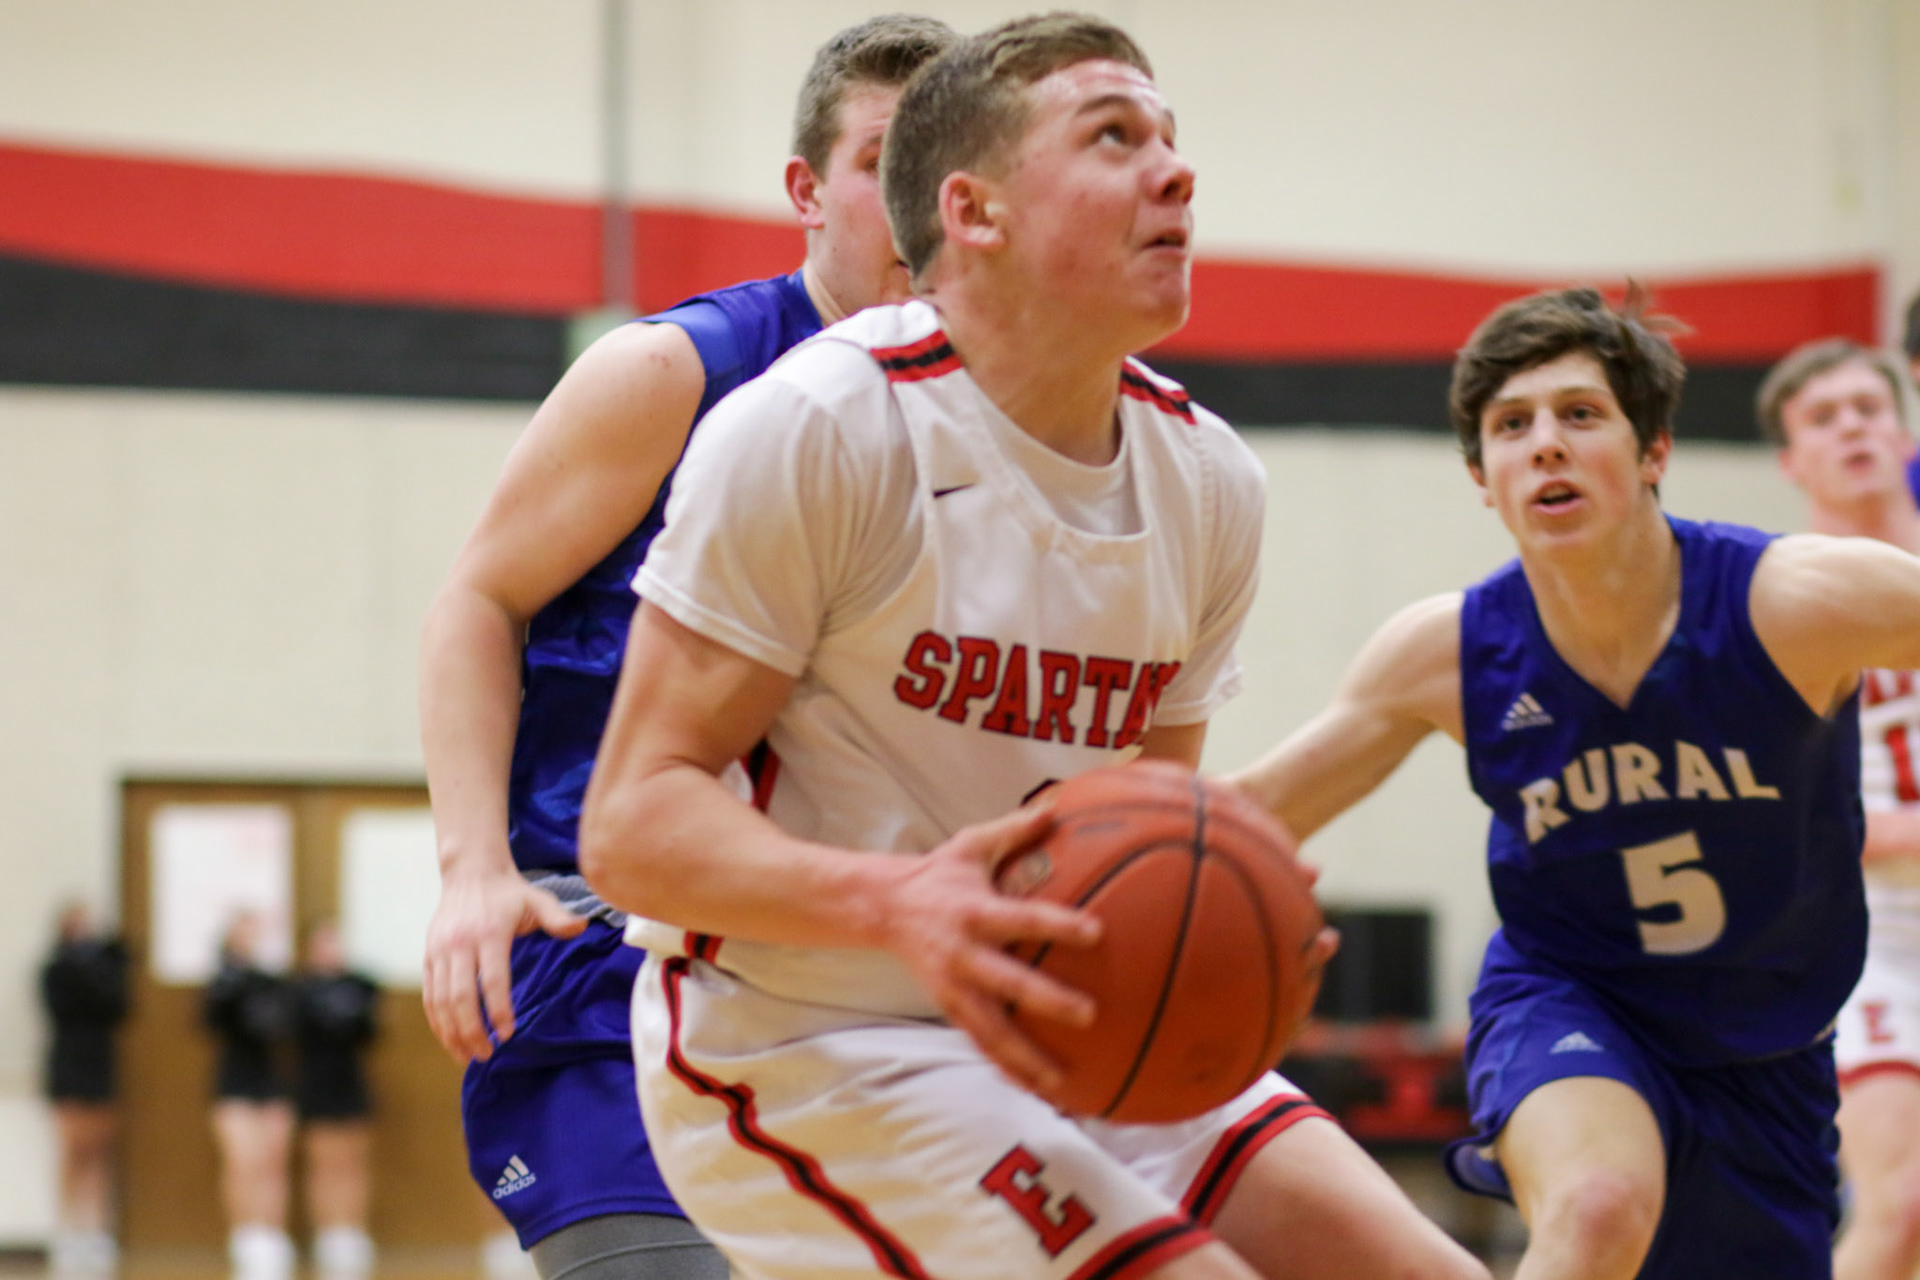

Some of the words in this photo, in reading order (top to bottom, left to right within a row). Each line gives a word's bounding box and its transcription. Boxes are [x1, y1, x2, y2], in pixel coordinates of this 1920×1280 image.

[1519, 740, 1782, 844] RURAL
[1620, 830, 1728, 957] 5
[493, 1172, 536, 1199] adidas
[978, 1142, 1096, 1260] E
